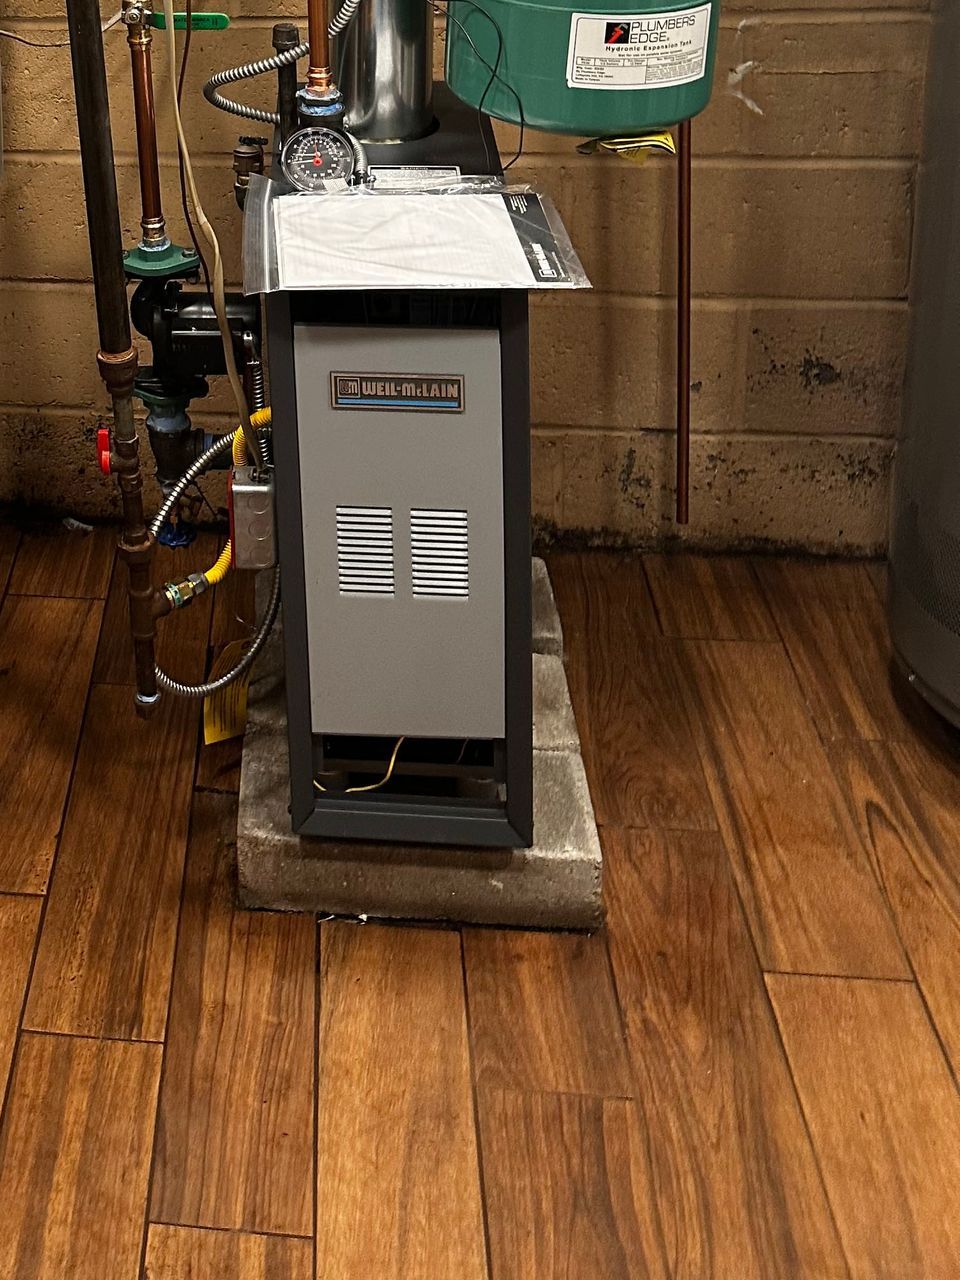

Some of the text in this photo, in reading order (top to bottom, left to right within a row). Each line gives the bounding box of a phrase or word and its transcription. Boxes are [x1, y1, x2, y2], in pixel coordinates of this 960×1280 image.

[631, 15, 696, 32] PLUMBERS
[629, 31, 667, 44] EDGE
[643, 43, 678, 52] Expansion
[680, 39, 692, 47] Tank
